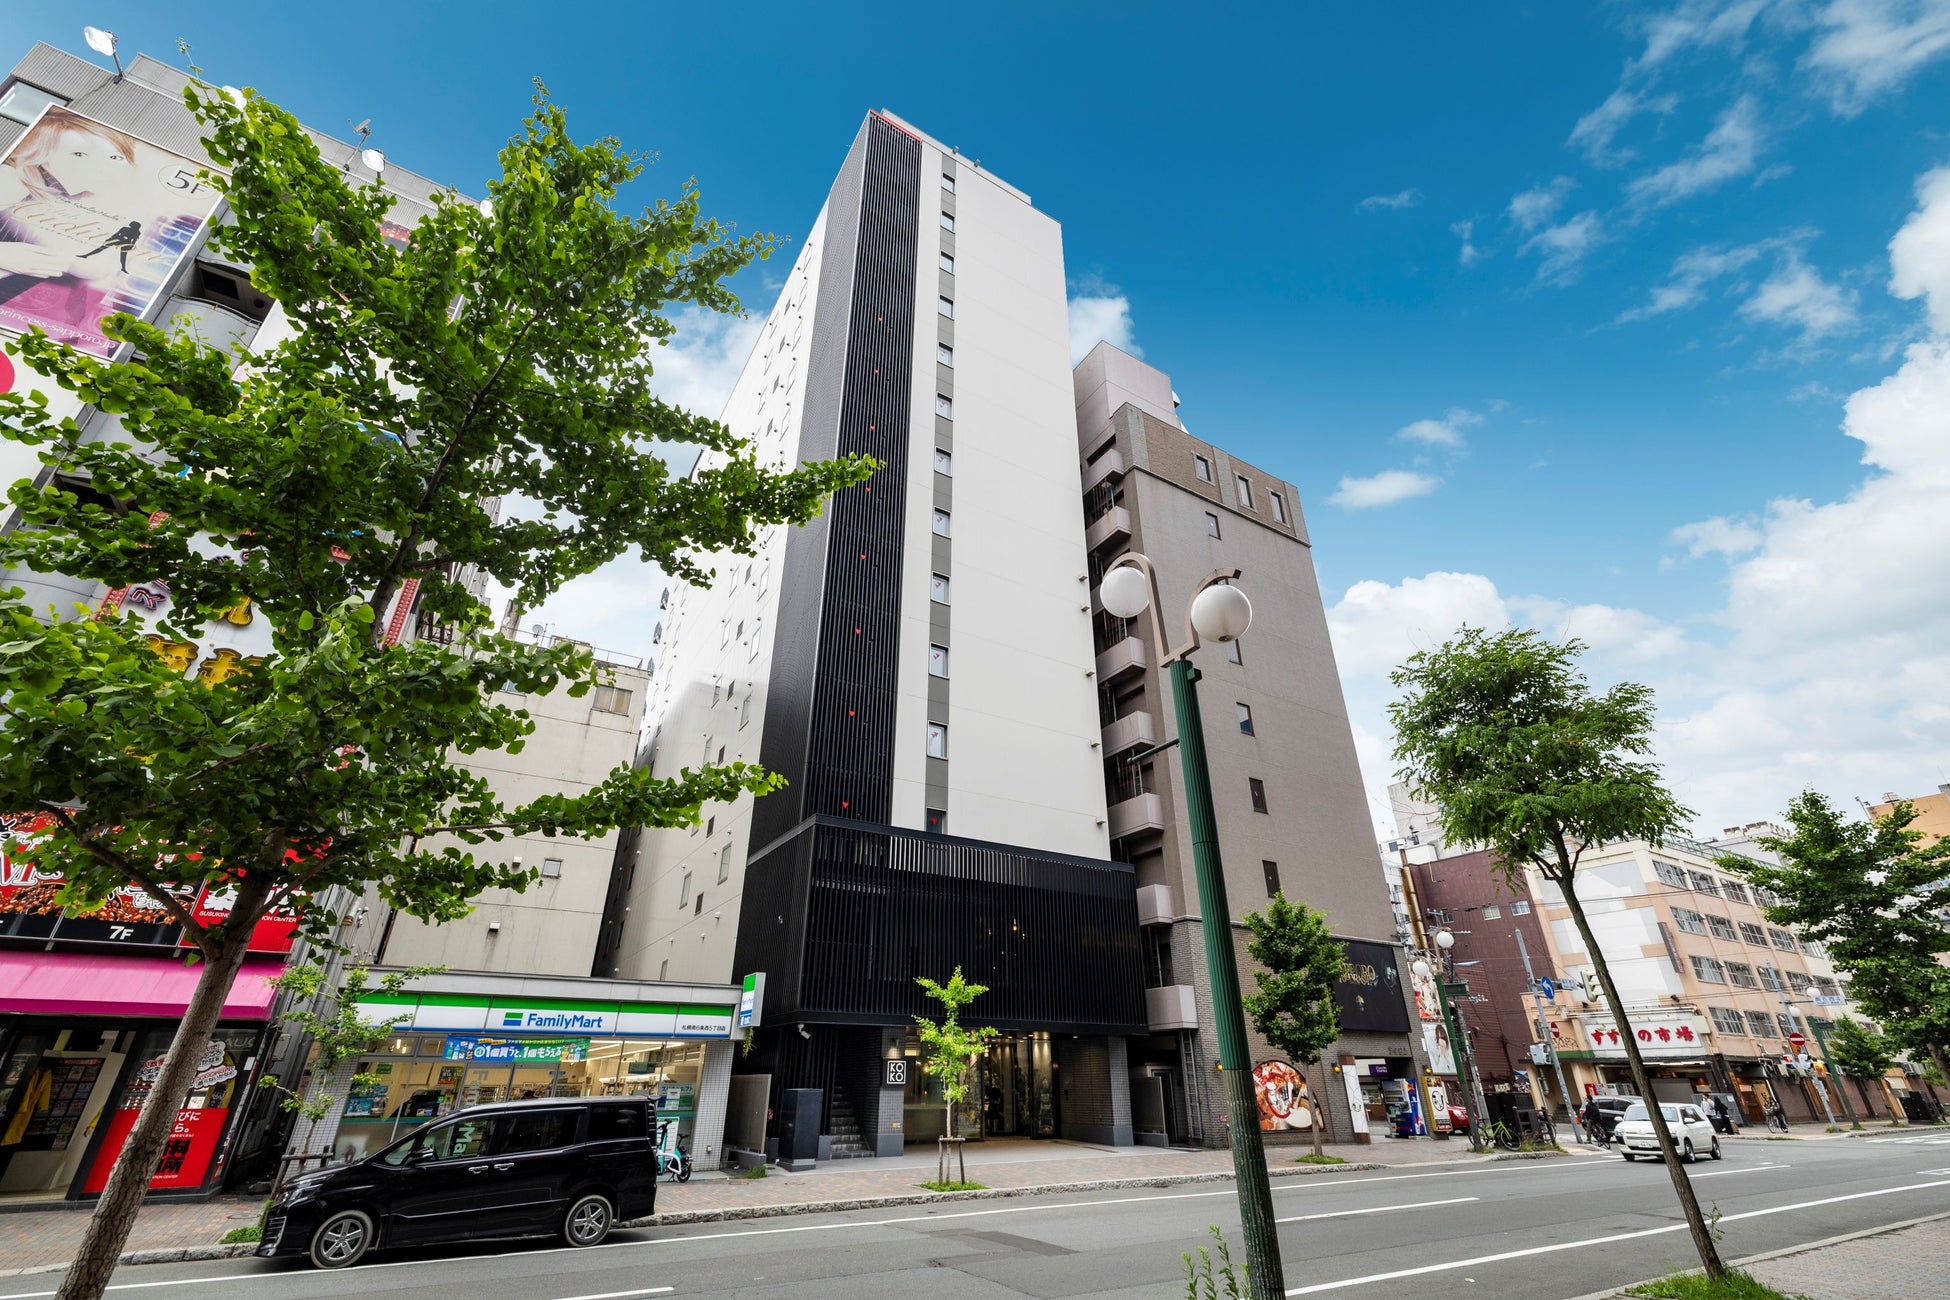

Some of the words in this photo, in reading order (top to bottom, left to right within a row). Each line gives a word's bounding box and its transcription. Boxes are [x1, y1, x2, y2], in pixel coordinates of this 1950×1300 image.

[166, 170, 209, 194] 5F
[109, 925, 134, 940] 7F
[527, 1013, 603, 1029] FamilyMart
[1591, 1026, 1694, 1045] すすの市場
[890, 1062, 903, 1072] KO
[890, 1072, 903, 1081] KO
[178, 1111, 201, 1121] びに
